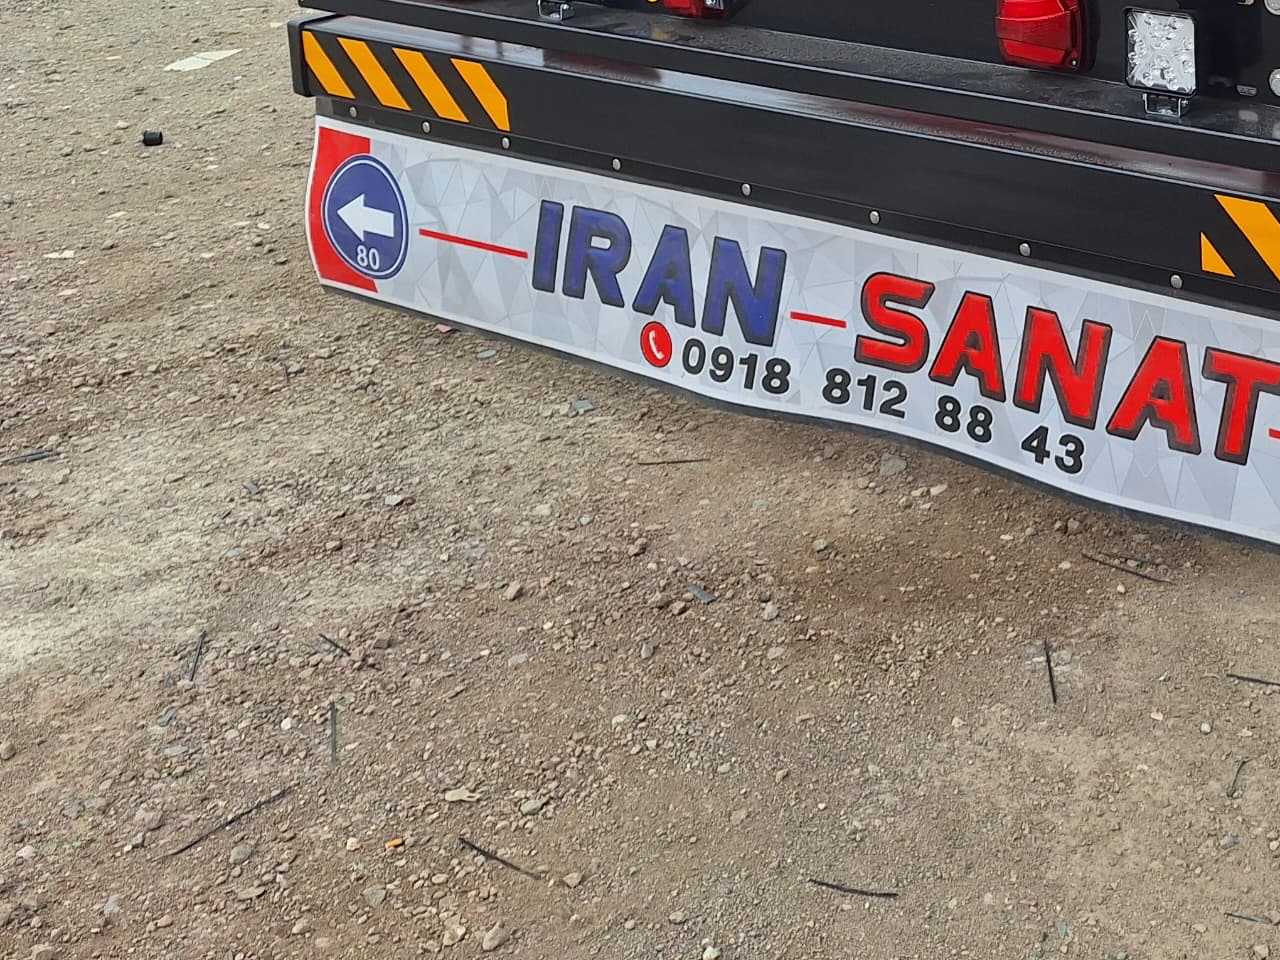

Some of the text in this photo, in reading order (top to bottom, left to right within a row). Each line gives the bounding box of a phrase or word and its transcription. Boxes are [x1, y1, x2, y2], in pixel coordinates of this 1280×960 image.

[356, 245, 380, 271] 80
[532, 199, 787, 347] IRAN
[682, 338, 1085, 474] 0918 812 88 43
